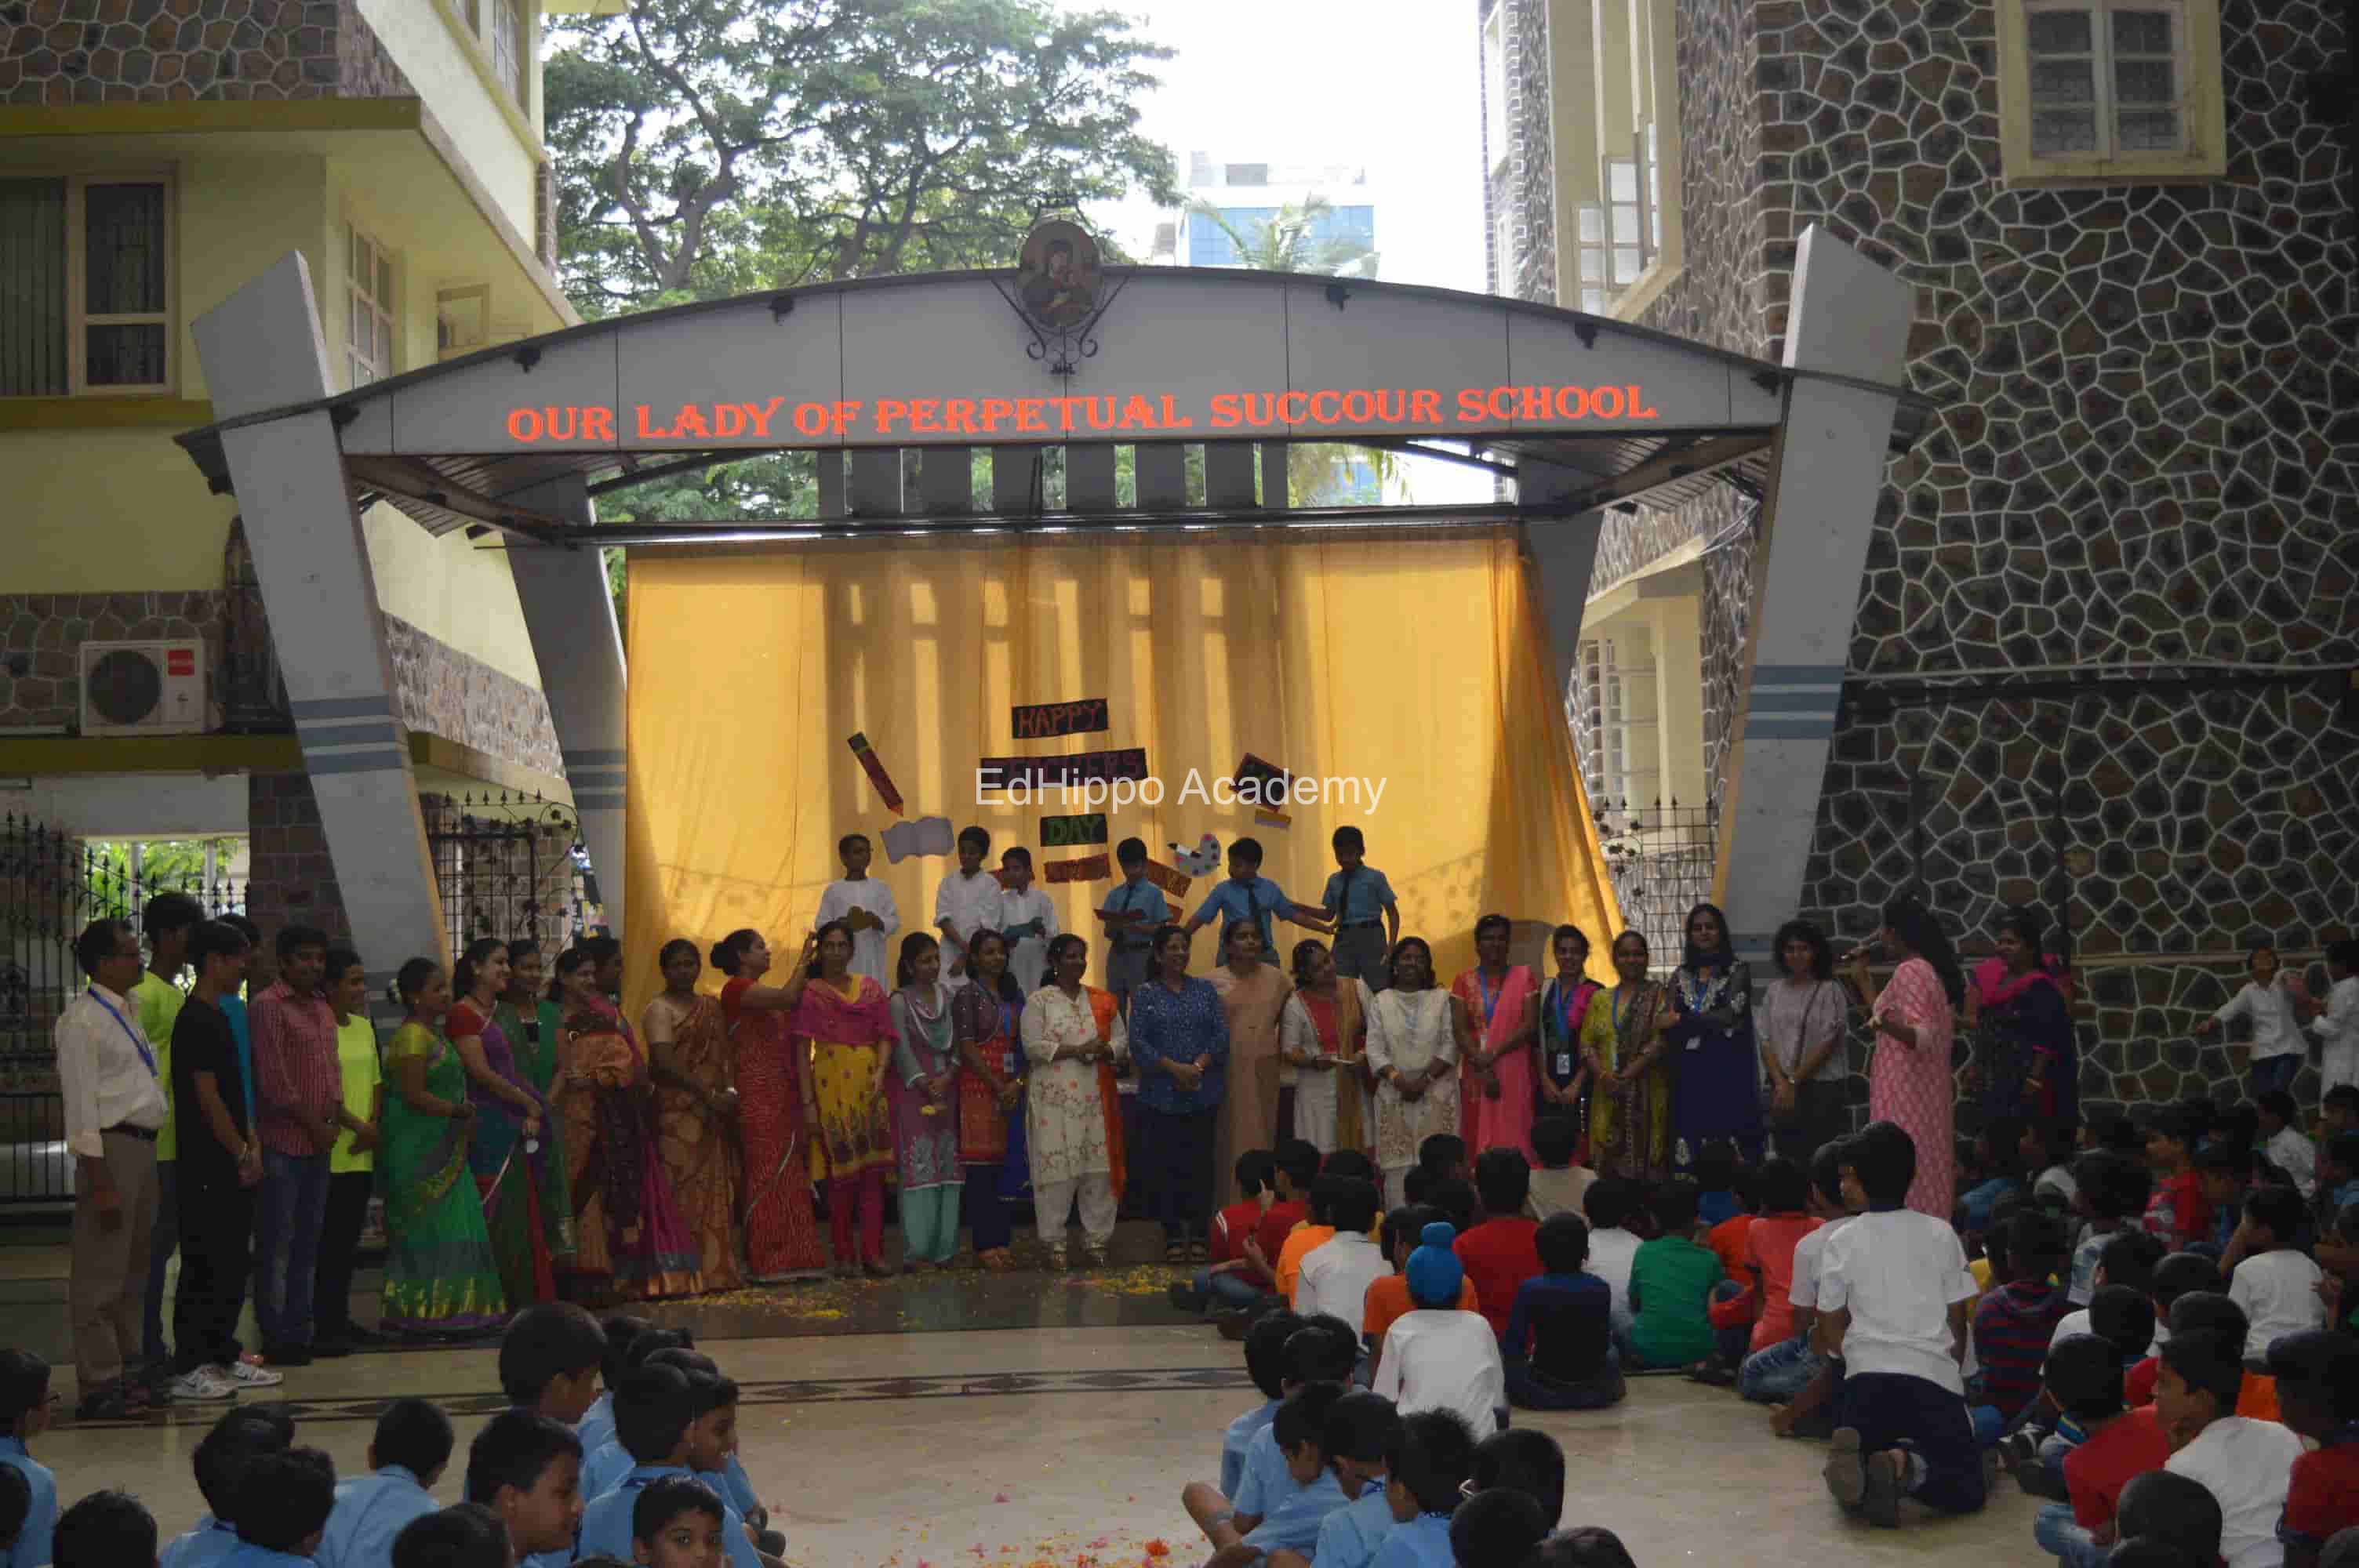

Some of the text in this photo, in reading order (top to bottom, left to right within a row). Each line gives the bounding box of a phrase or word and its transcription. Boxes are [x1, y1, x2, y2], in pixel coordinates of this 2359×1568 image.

[506, 385, 1658, 443] OUR LADY OF PERPETUAL SUCCOUR SCHOOL
[1016, 700, 1102, 737] HAPPY
[1046, 816, 1100, 846] DAY
